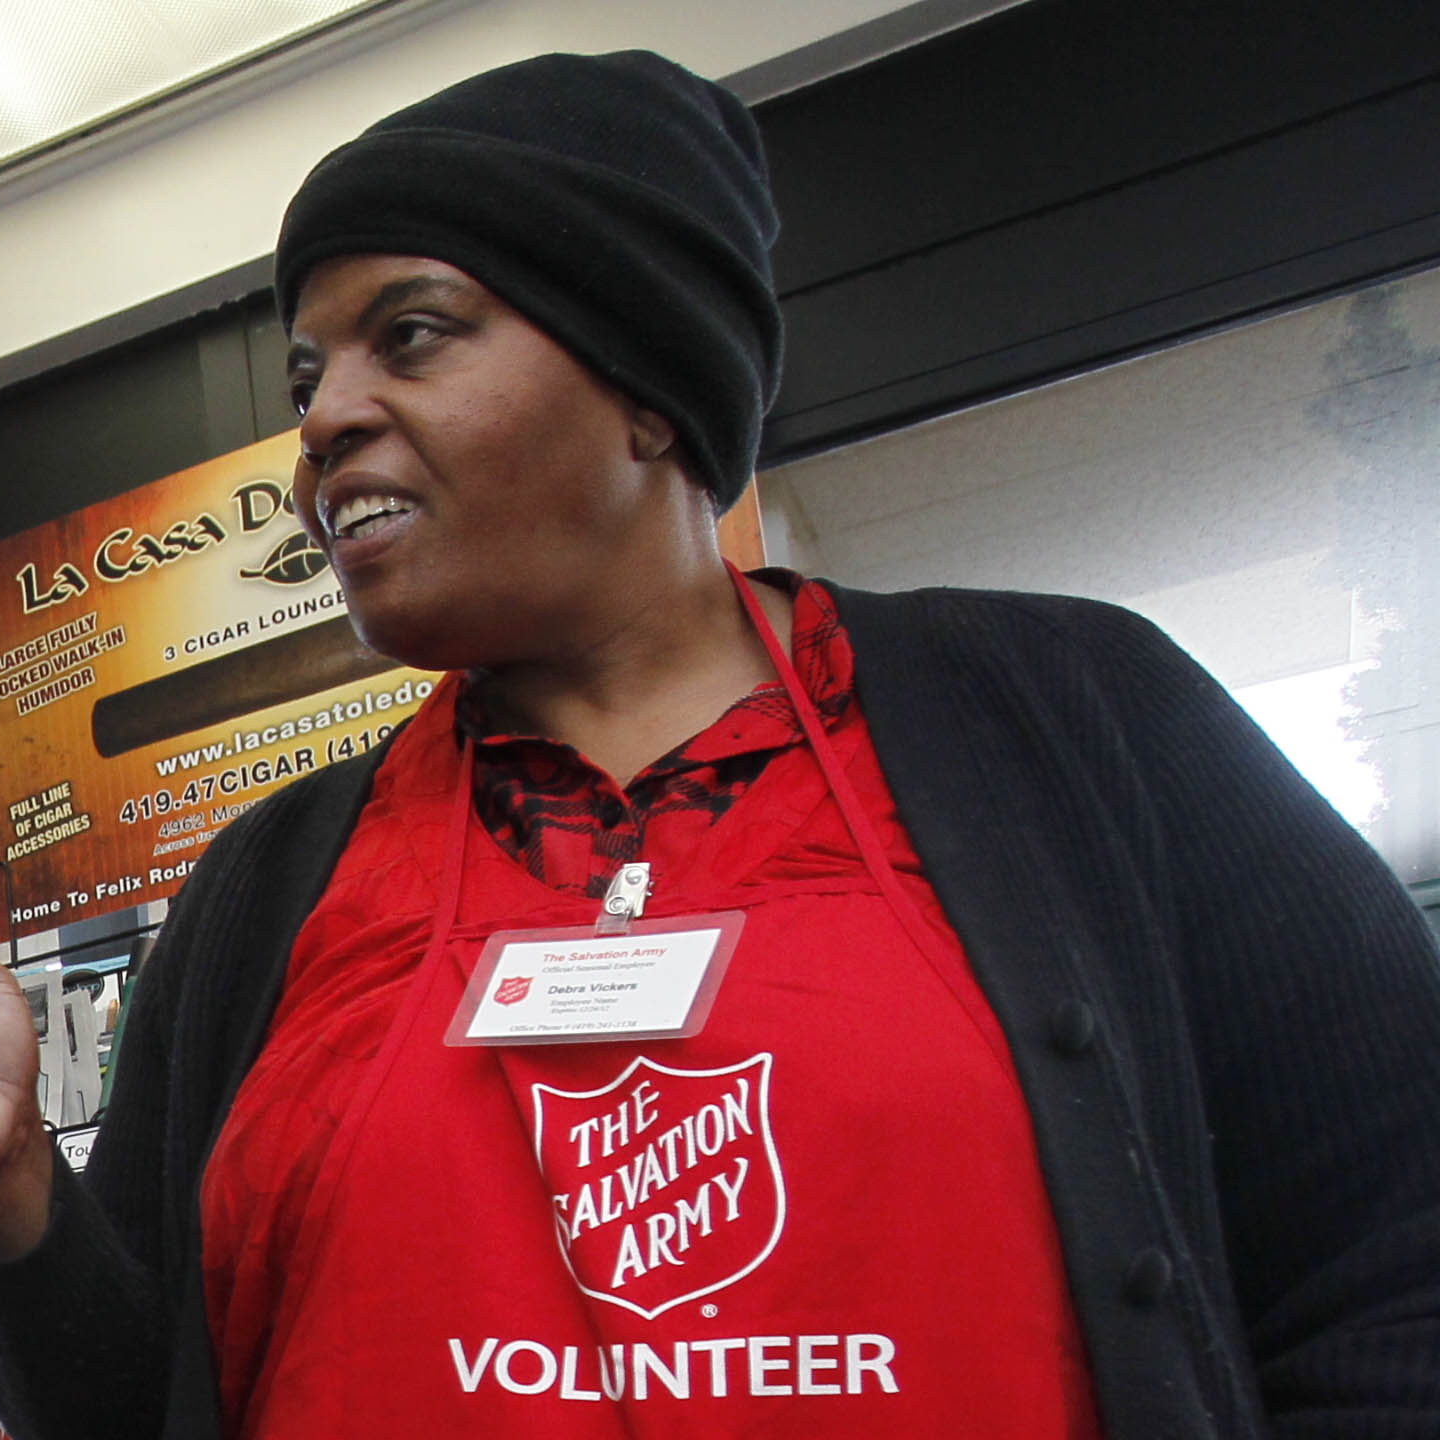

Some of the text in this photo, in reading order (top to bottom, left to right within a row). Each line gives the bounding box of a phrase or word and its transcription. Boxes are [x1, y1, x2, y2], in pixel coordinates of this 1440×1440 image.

[17, 562, 90, 614] La
[94, 511, 227, 583] Casa
[49, 613, 96, 648] FULLY
[53, 627, 124, 673] WALK-IN
[164, 647, 177, 662] 3
[184, 620, 250, 655] CIGAR
[18, 668, 94, 714] HUMIDOR
[10, 783, 71, 820] FULL LINE
[120, 747, 315, 823] 419.47CIGAR
[7, 814, 91, 861] ACCESSORIES
[15, 801, 73, 837] OF CIGAR
[158, 814, 206, 838] 4962
[11, 901, 62, 925] Home
[67, 892, 89, 908] To
[95, 876, 143, 900] Felix
[543, 946, 668, 963] The Salvation Army
[548, 981, 639, 995] Debra Vickers
[570, 1080, 660, 1168] THE
[551, 1077, 753, 1243] SALVATION
[610, 1157, 749, 1289] ARMY
[447, 1333, 901, 1402] VOLUNTEER
